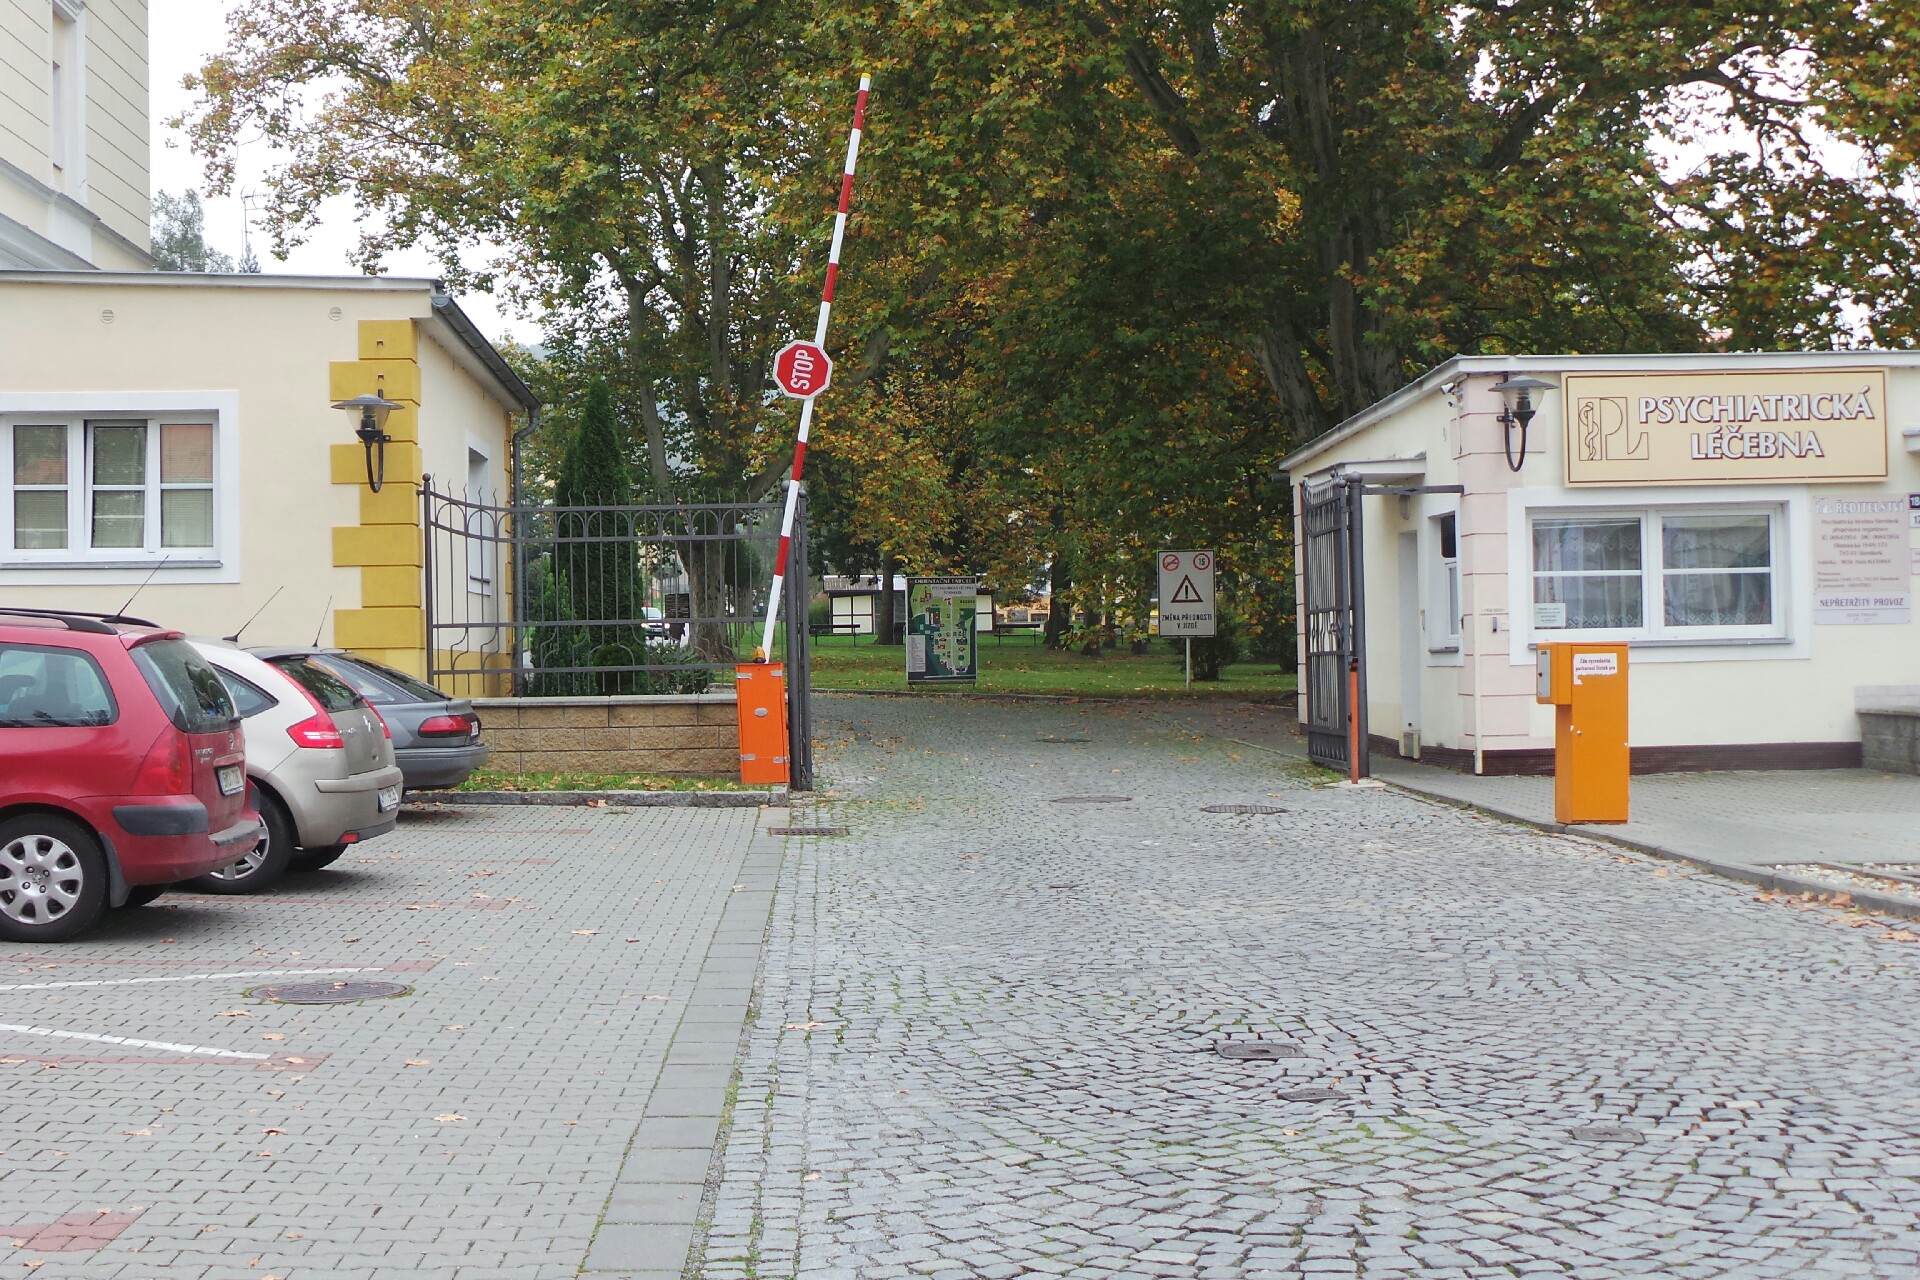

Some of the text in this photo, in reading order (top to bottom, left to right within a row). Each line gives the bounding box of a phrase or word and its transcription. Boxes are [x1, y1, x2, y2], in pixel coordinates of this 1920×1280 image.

[790, 349, 814, 390] STOP
[1638, 385, 1875, 424] PSYCHIATRICKÁ
[1691, 425, 1825, 460] LÉČEBNA
[1836, 499, 1904, 513] ŘEDITELSTVÍ
[1198, 558, 1206, 566] 15
[1820, 597, 1904, 607] NEPŘETRŽITÝ PROVOZ
[1161, 613, 1212, 622] ZMĚNA PŘEDNOSTI
